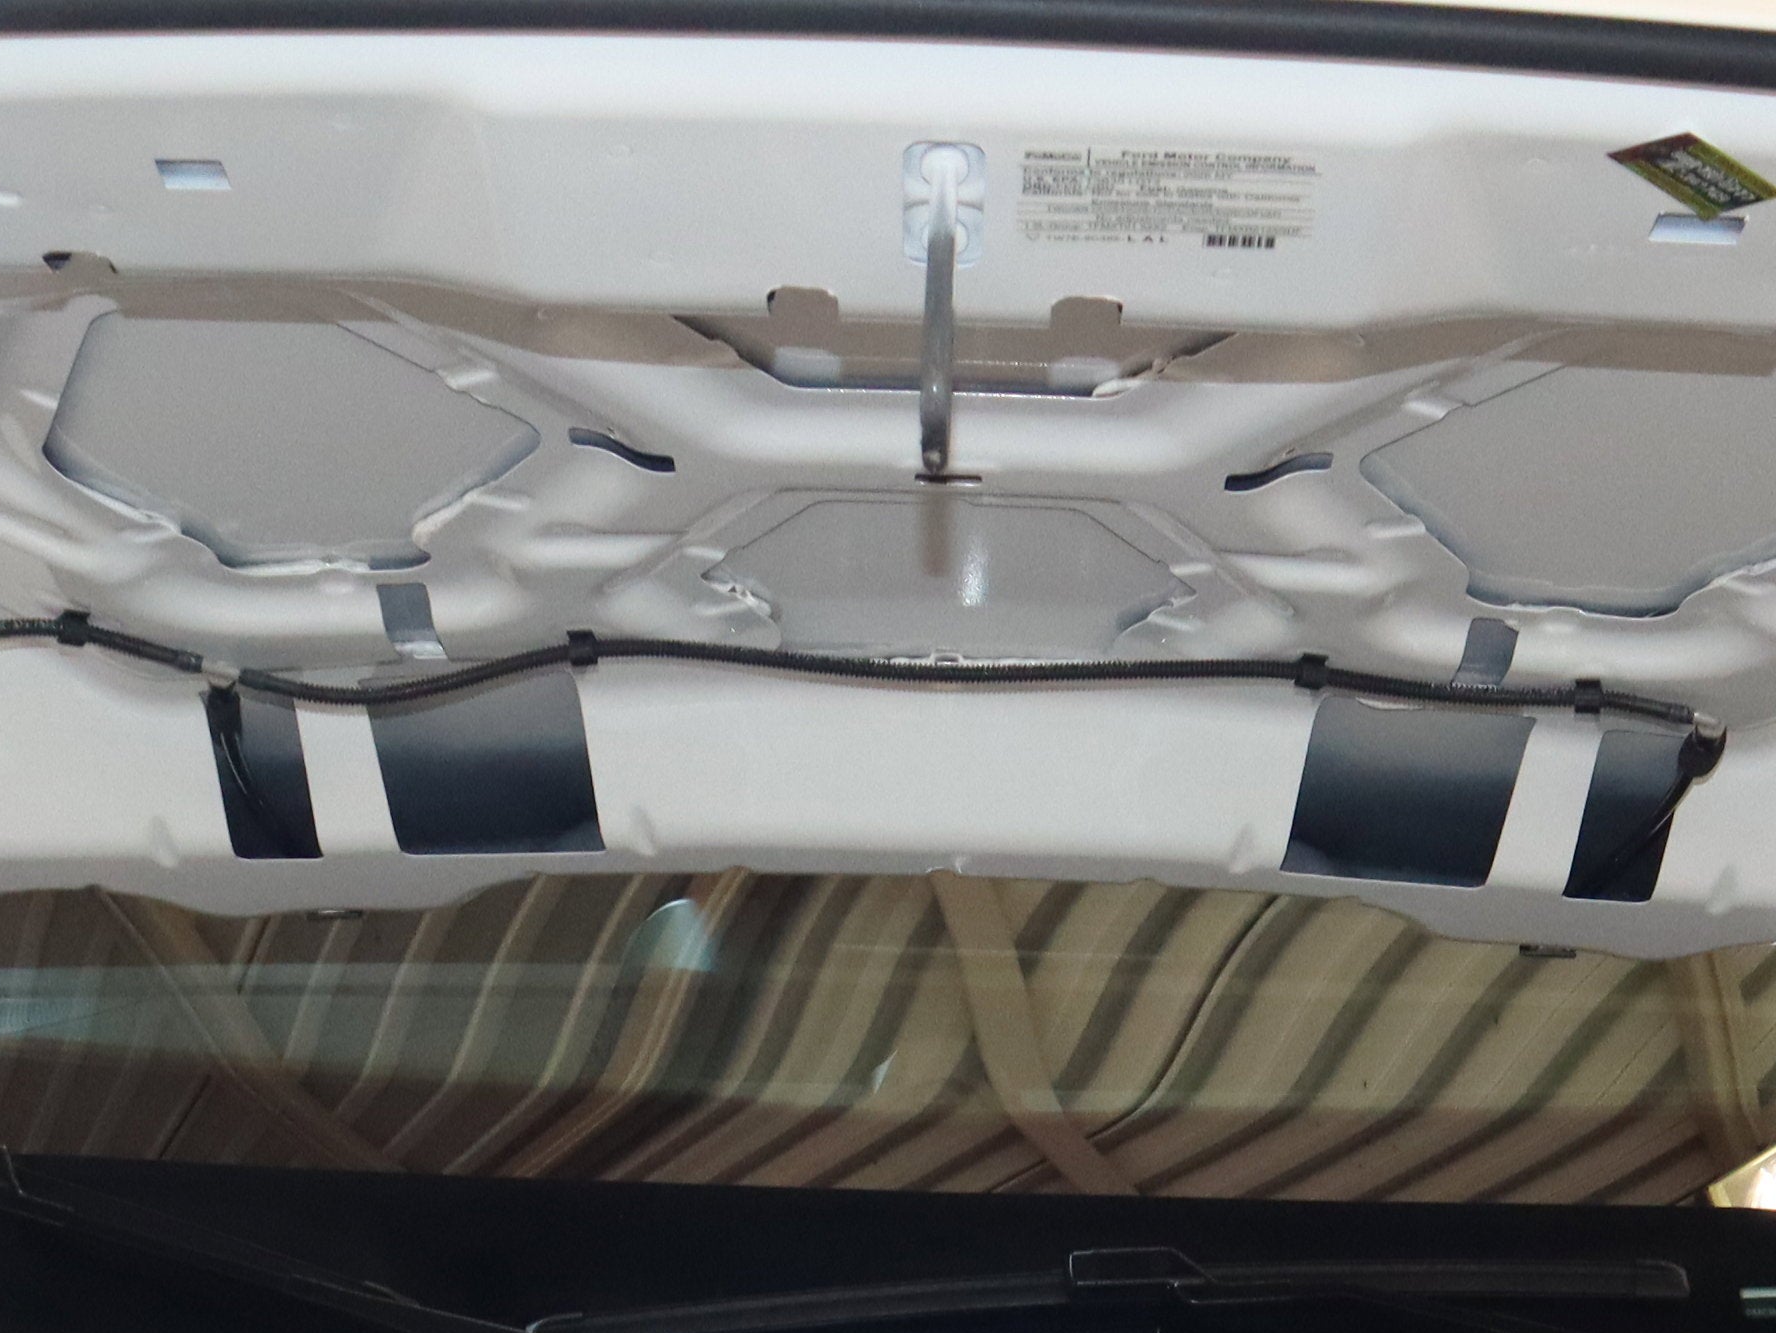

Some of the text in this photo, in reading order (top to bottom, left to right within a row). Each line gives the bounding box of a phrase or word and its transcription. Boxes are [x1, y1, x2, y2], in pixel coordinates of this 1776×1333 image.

[1121, 150, 1291, 164] Ford Motor Company
